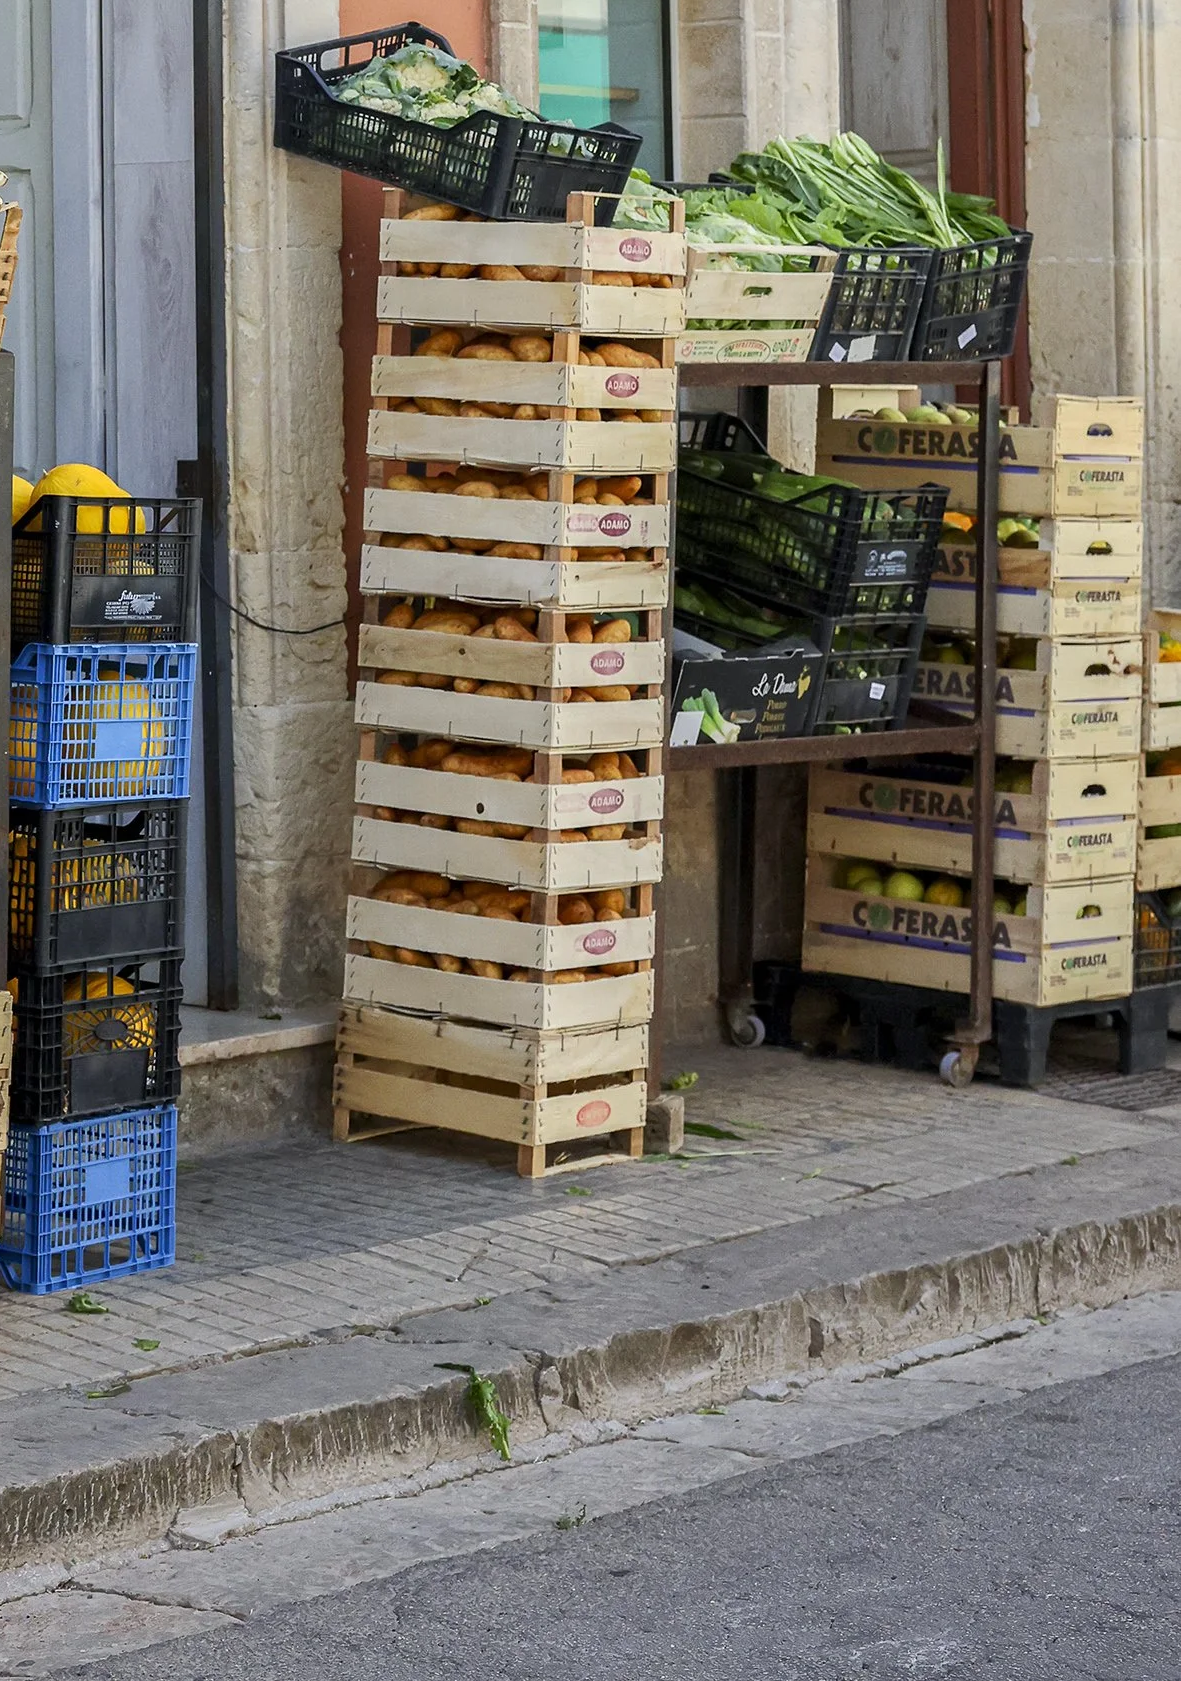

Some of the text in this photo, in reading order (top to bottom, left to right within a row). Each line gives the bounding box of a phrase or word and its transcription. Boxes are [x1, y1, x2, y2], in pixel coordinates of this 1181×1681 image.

[621, 243, 650, 256] ADAMO
[607, 380, 637, 391] ADAMO
[857, 425, 1018, 460] COFERASA
[1080, 470, 1125, 482] COFERASTA
[600, 519, 630, 530] ADAMO
[1075, 590, 1121, 603] COFERASTA
[592, 657, 623, 670] ADAMO
[1071, 711, 1119, 724] COFERASTA
[591, 795, 622, 808] ADAMO
[1066, 833, 1113, 848] COFERASTA
[852, 900, 1012, 949] COFERASA
[585, 935, 614, 948] ADAMO
[1060, 953, 1108, 970] COFERASTA
